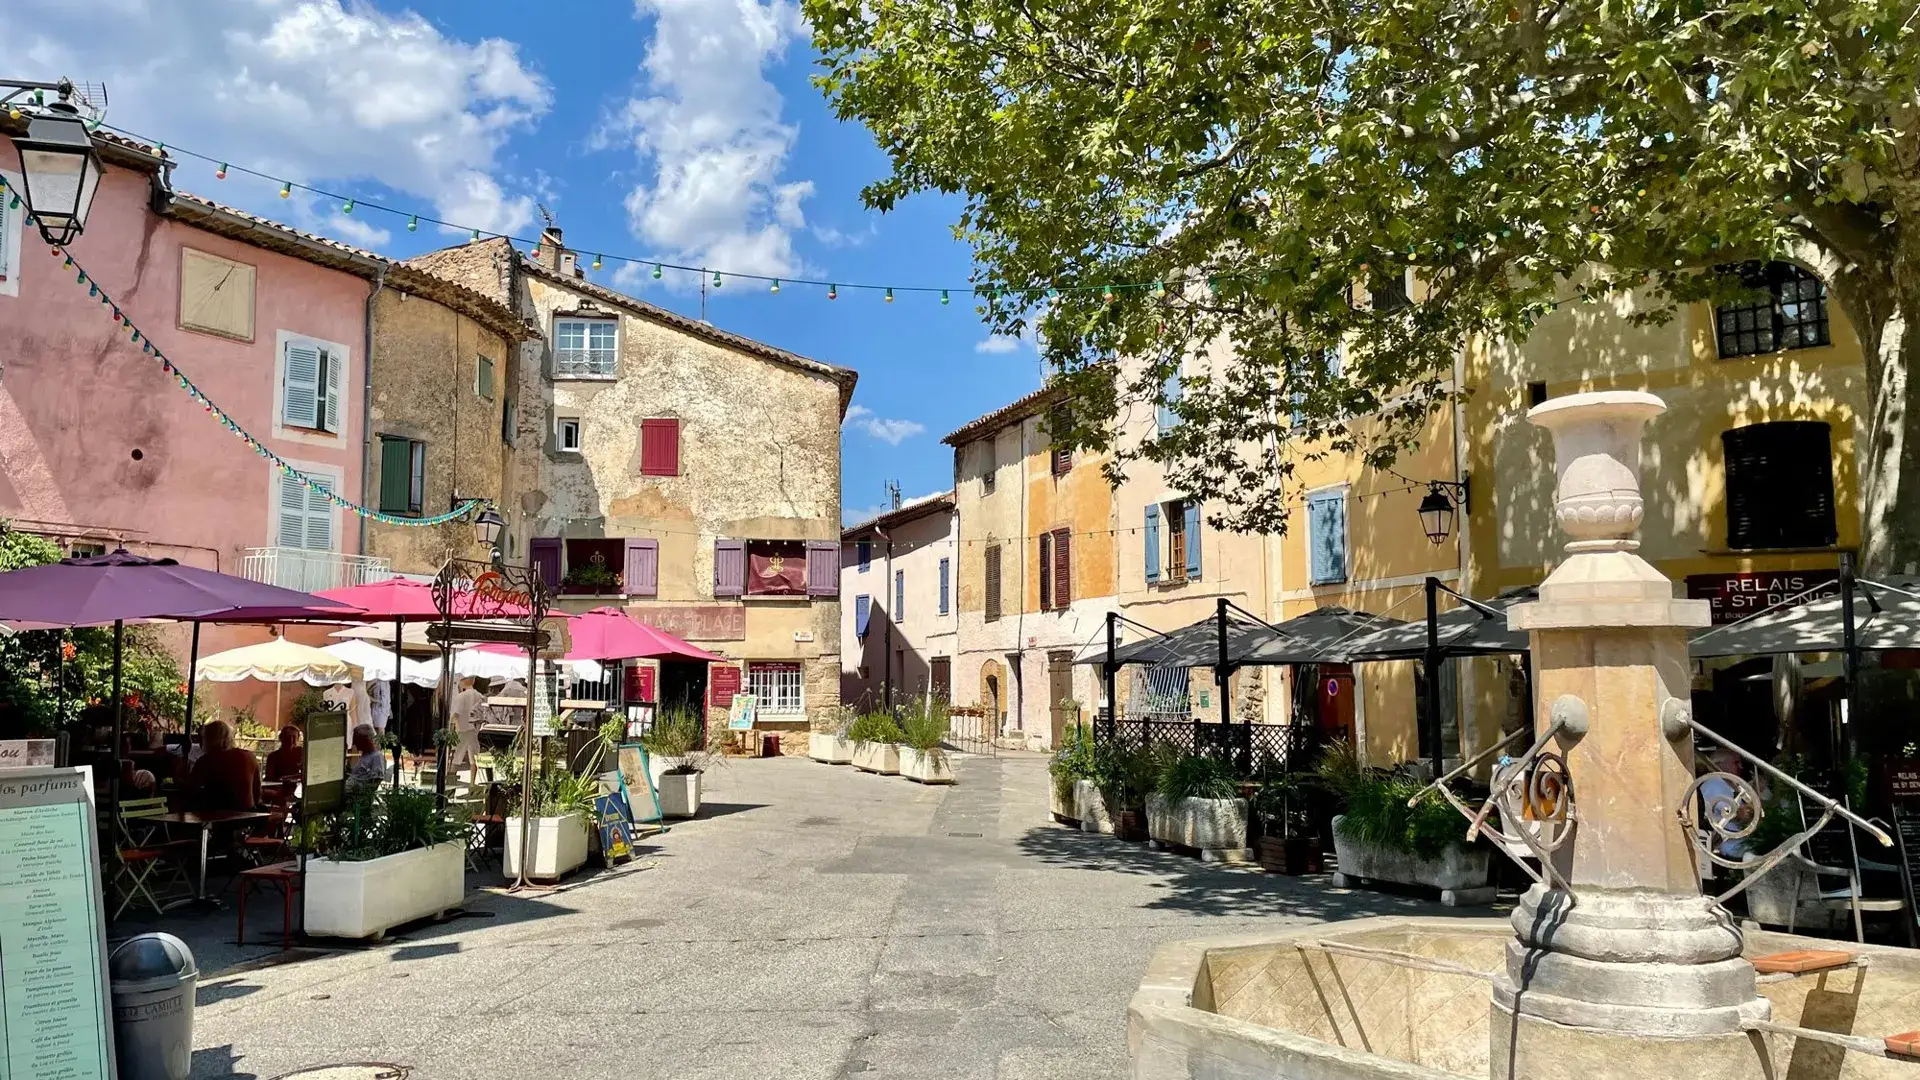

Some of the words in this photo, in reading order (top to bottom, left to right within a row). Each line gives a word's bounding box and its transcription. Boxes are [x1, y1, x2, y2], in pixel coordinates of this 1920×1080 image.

[1726, 577, 1805, 592] RELAIS
[1711, 597, 1723, 608] E
[1732, 595, 1757, 607] ST
[21, 779, 78, 797] parfums
